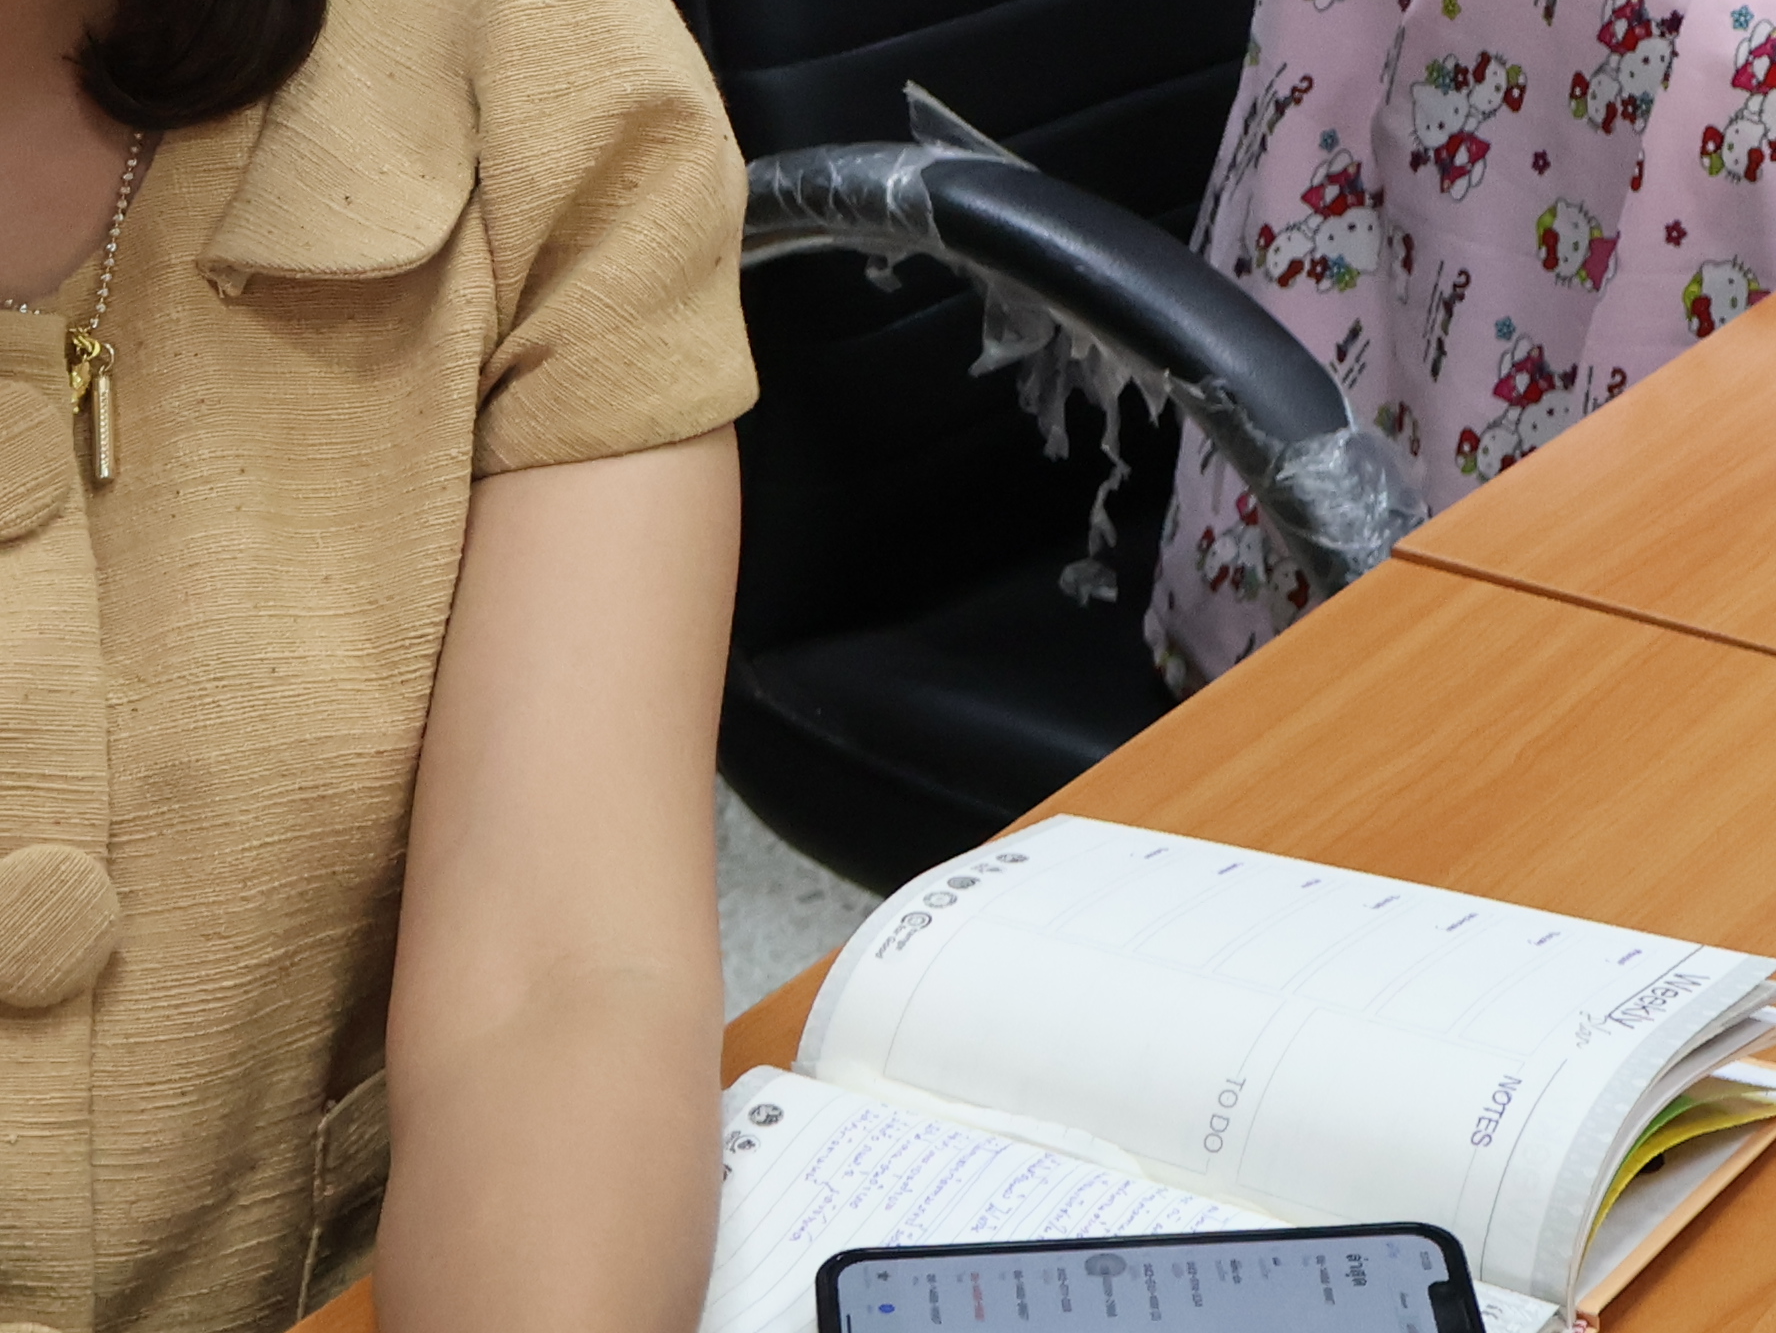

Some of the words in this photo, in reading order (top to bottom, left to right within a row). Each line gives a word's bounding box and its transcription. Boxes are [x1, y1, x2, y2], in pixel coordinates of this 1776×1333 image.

[1608, 971, 1711, 1031] Weekly
[1218, 1076, 1247, 1109] TO
[1469, 1074, 1523, 1148] NOTES
[1203, 1113, 1230, 1155] DO
